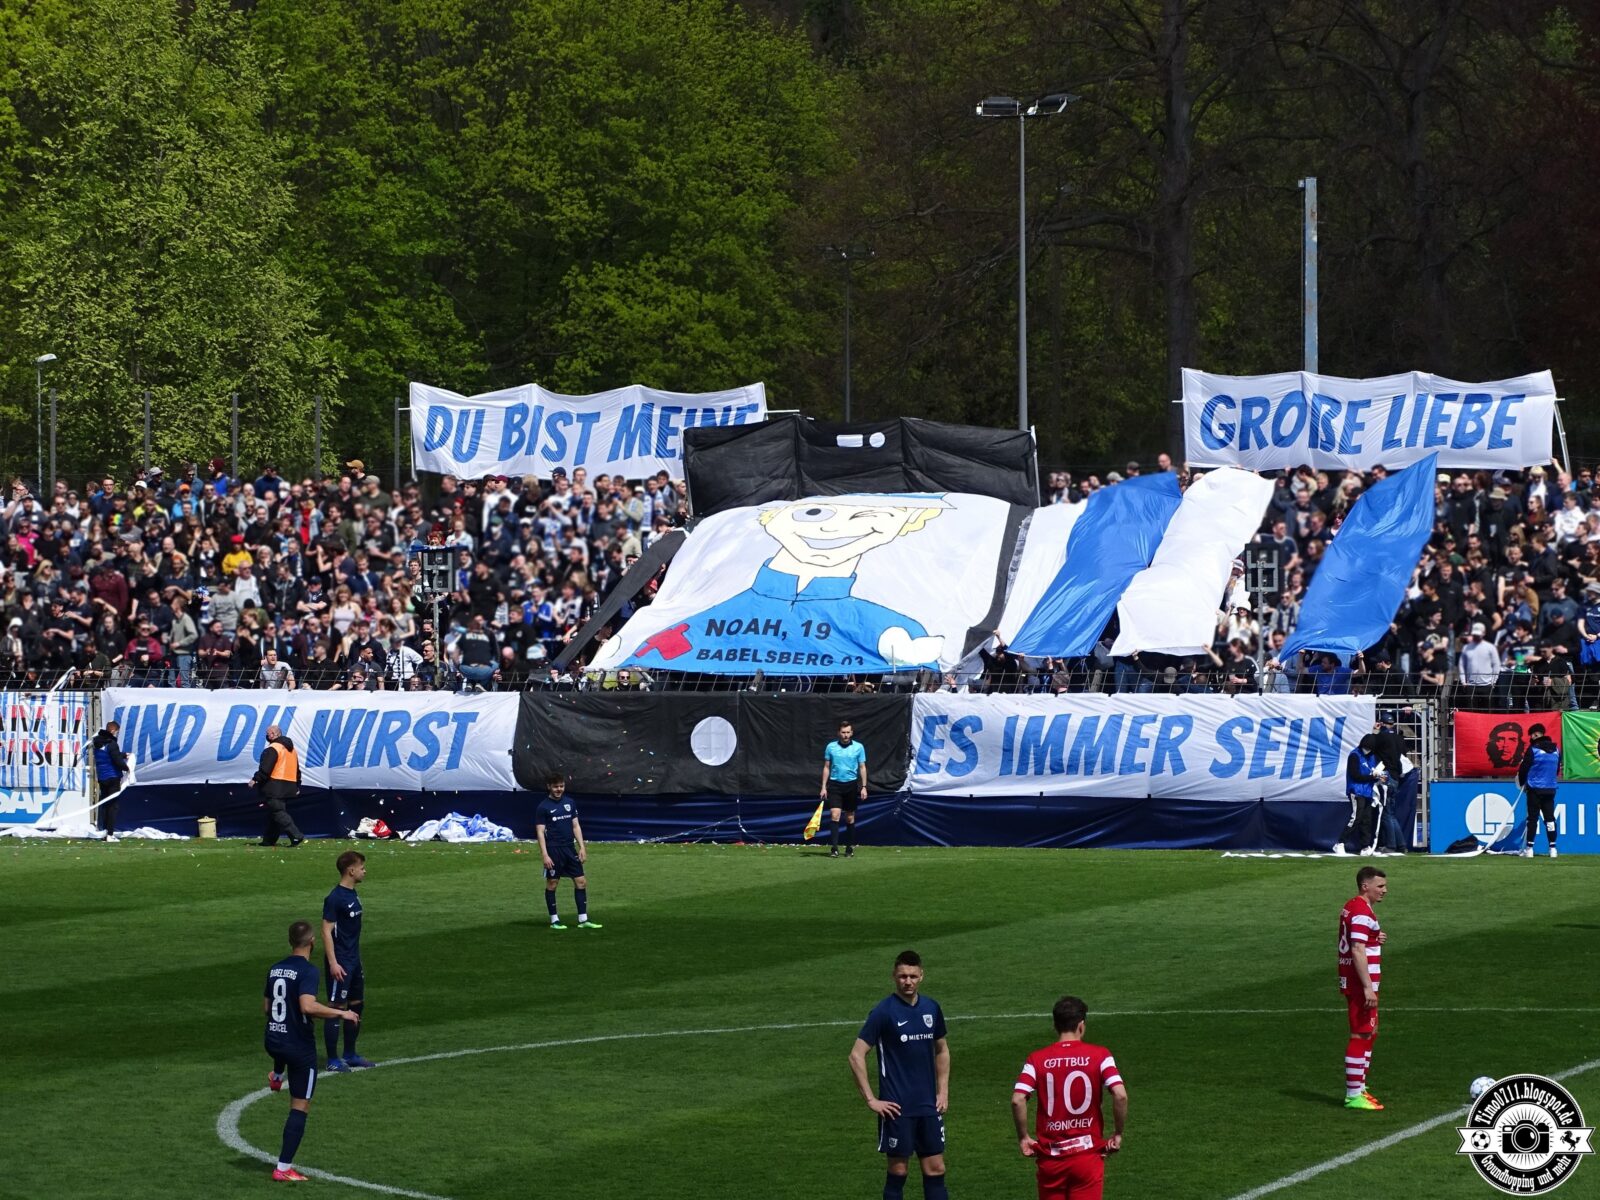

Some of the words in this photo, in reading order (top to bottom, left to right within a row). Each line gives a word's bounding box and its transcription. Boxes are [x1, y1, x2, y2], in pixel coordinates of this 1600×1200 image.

[424, 405, 485, 463] DU
[498, 402, 600, 466] BIST
[1381, 393, 1526, 450] LIEBE
[705, 618, 787, 641] NOAH,
[801, 619, 831, 640] 19
[696, 648, 834, 666] BABELSBERG
[217, 704, 297, 763] DU
[305, 708, 479, 771] WIRST
[914, 714, 984, 776] ES
[999, 713, 1193, 776] IMMER
[1208, 716, 1346, 779] SEIN
[272, 979, 287, 1022] 8
[1044, 1056, 1091, 1069] COTTBUS
[1046, 1070, 1093, 1117] 10
